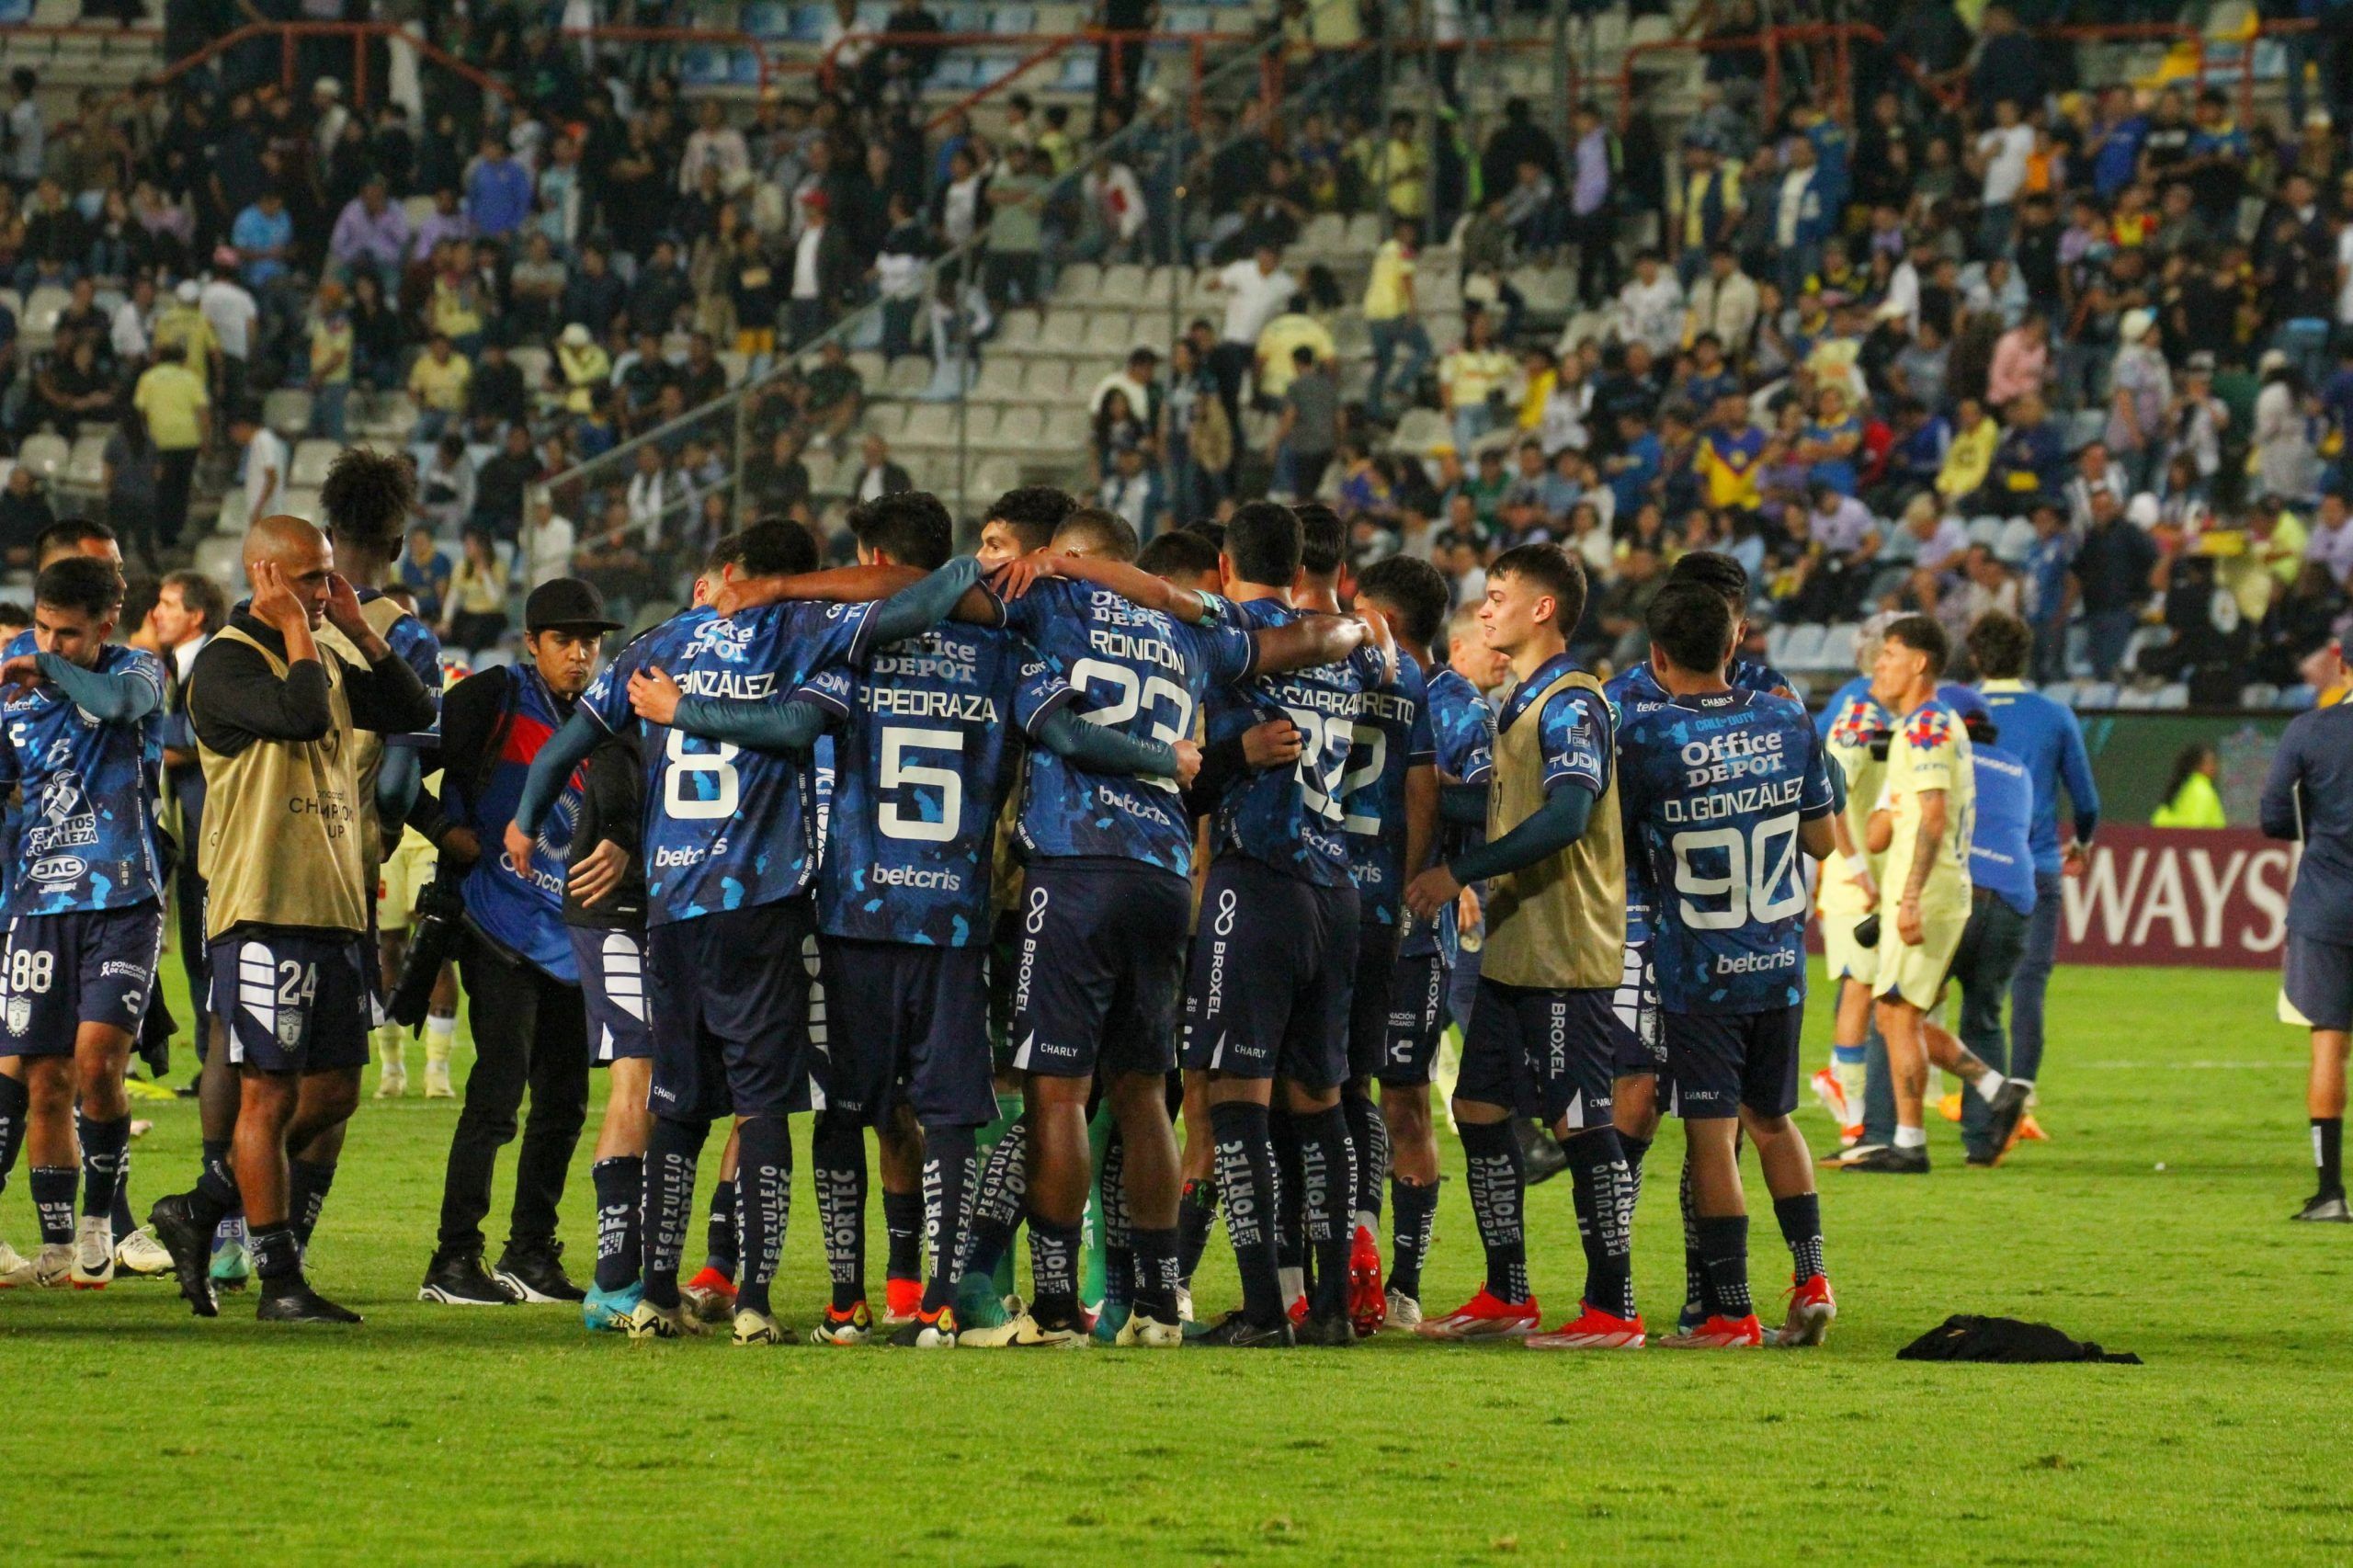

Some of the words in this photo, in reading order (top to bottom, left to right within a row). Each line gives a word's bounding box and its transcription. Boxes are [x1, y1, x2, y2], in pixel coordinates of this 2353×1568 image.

[874, 655, 976, 683] DEPOT
[873, 687, 999, 723] PEDRAZA
[1636, 700, 1669, 713] telce
[1701, 696, 1733, 707] CHARLY
[1681, 731, 1782, 767] Office
[665, 728, 739, 820] 8
[879, 727, 964, 842] 5
[1687, 752, 1784, 788] DEPOT
[872, 863, 961, 892] betcris
[11, 949, 53, 994] 88
[1015, 938, 1036, 1017] BROXEL
[1207, 941, 1226, 1020] BROXEL
[1716, 947, 1796, 974] betcris
[278, 960, 320, 1007] 24
[1040, 1042, 1078, 1057] CHARLY
[1551, 1003, 1565, 1080] BROXEL
[1486, 1154, 1519, 1227] FORTEC
[831, 1169, 858, 1260] FORTEC
